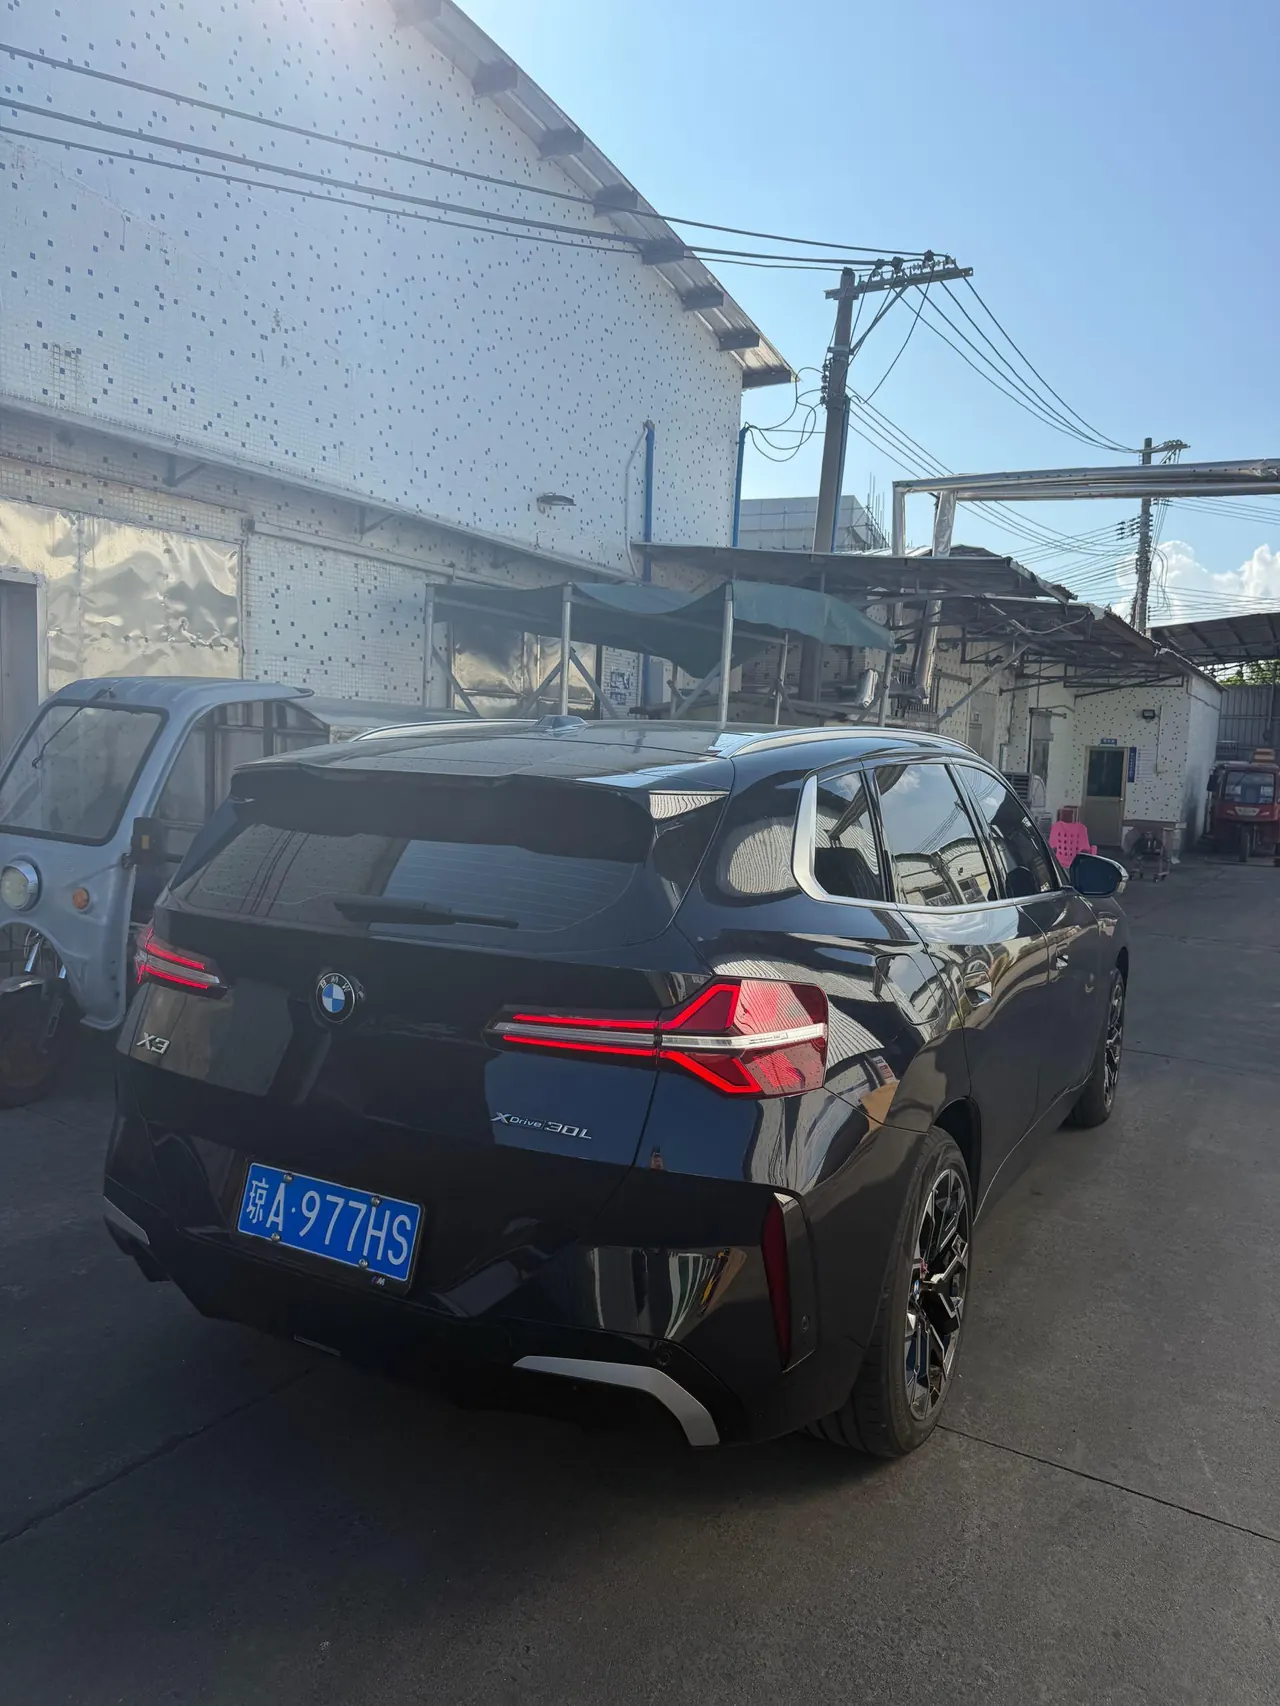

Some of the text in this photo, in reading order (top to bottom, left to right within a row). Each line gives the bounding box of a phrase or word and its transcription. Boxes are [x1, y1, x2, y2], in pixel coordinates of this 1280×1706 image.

[320, 975, 351, 992] BMW
[136, 1031, 170, 1054] X3
[545, 1121, 592, 1140] 30L
